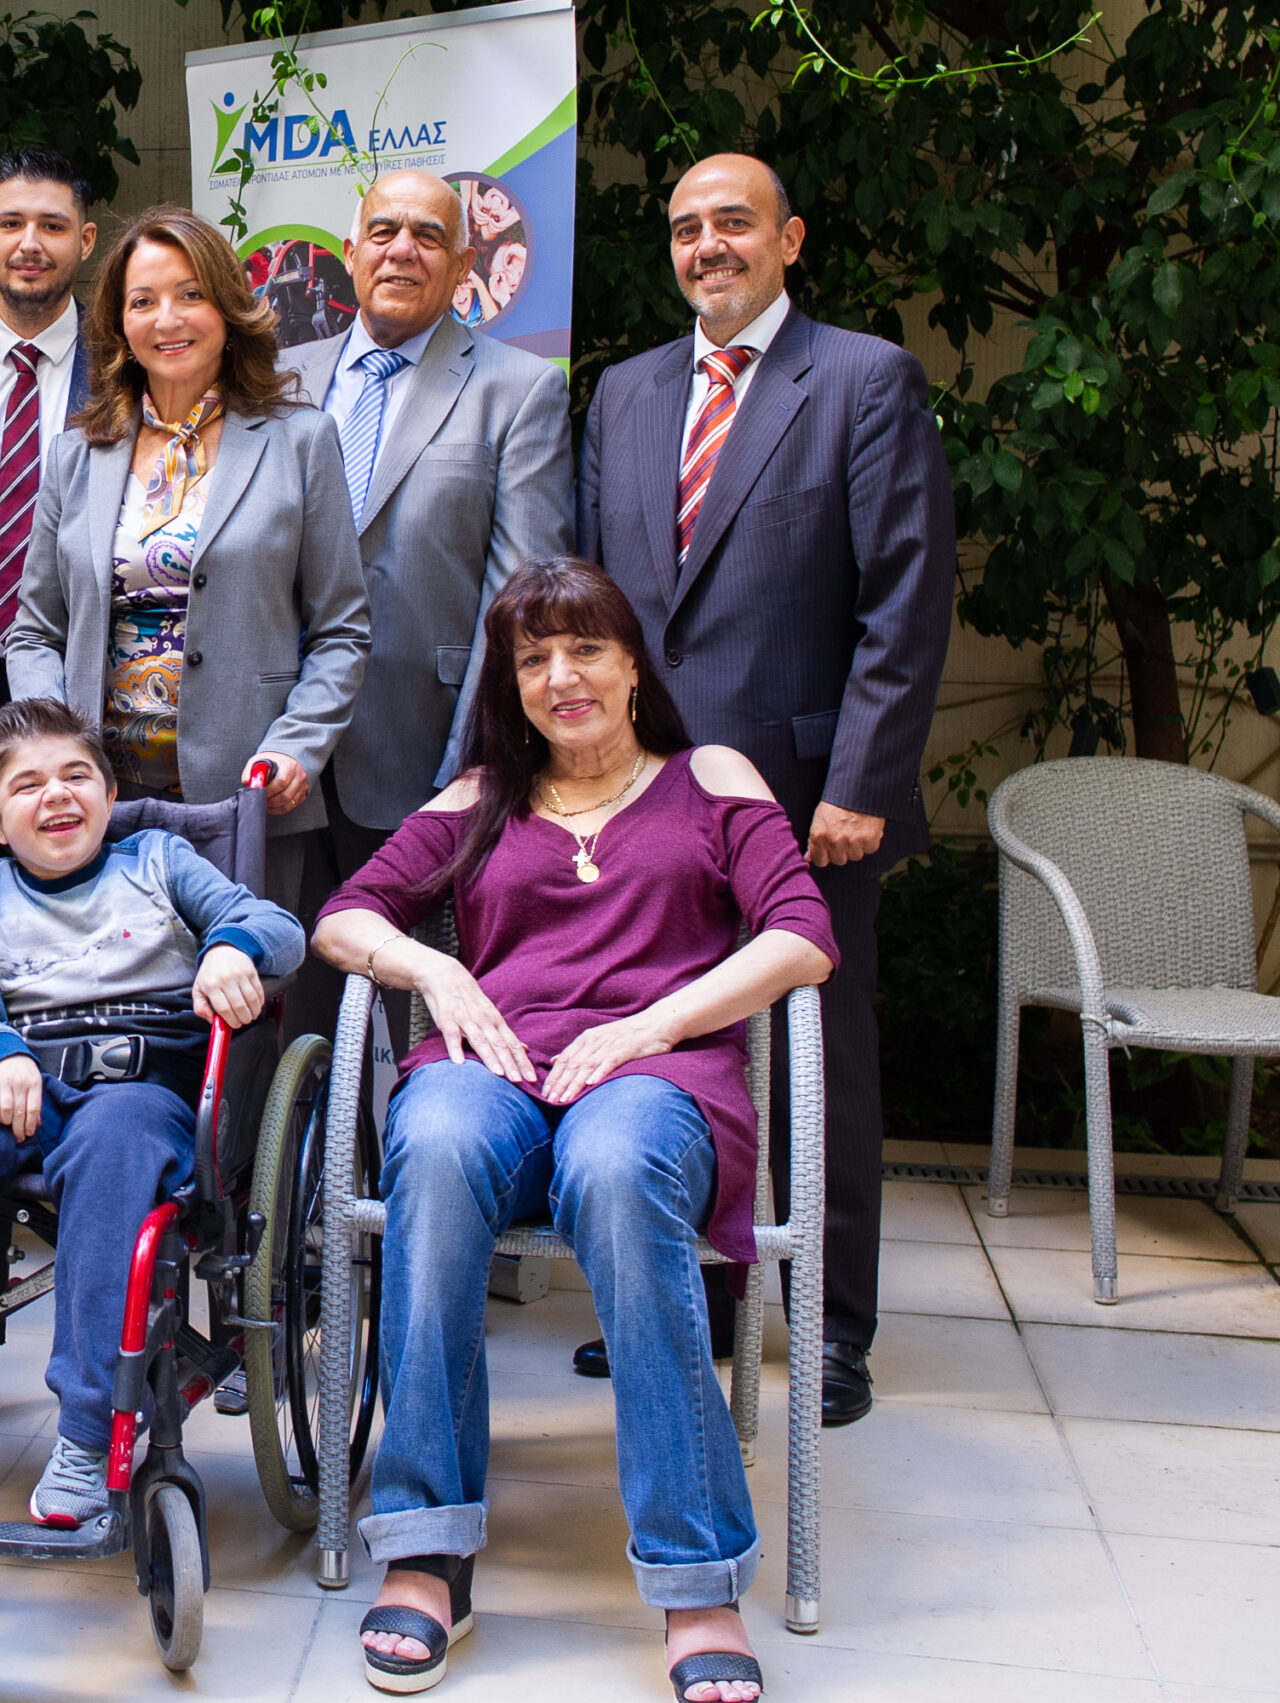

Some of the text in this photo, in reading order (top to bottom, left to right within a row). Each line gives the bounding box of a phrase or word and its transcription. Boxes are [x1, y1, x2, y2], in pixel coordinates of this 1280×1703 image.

[244, 110, 447, 163] MDA ΕΛΛΑΣ
[209, 177, 241, 191] ΣΩΜΑΤΕΙ
[291, 167, 328, 180] ΑΤΟΜΩΝ
